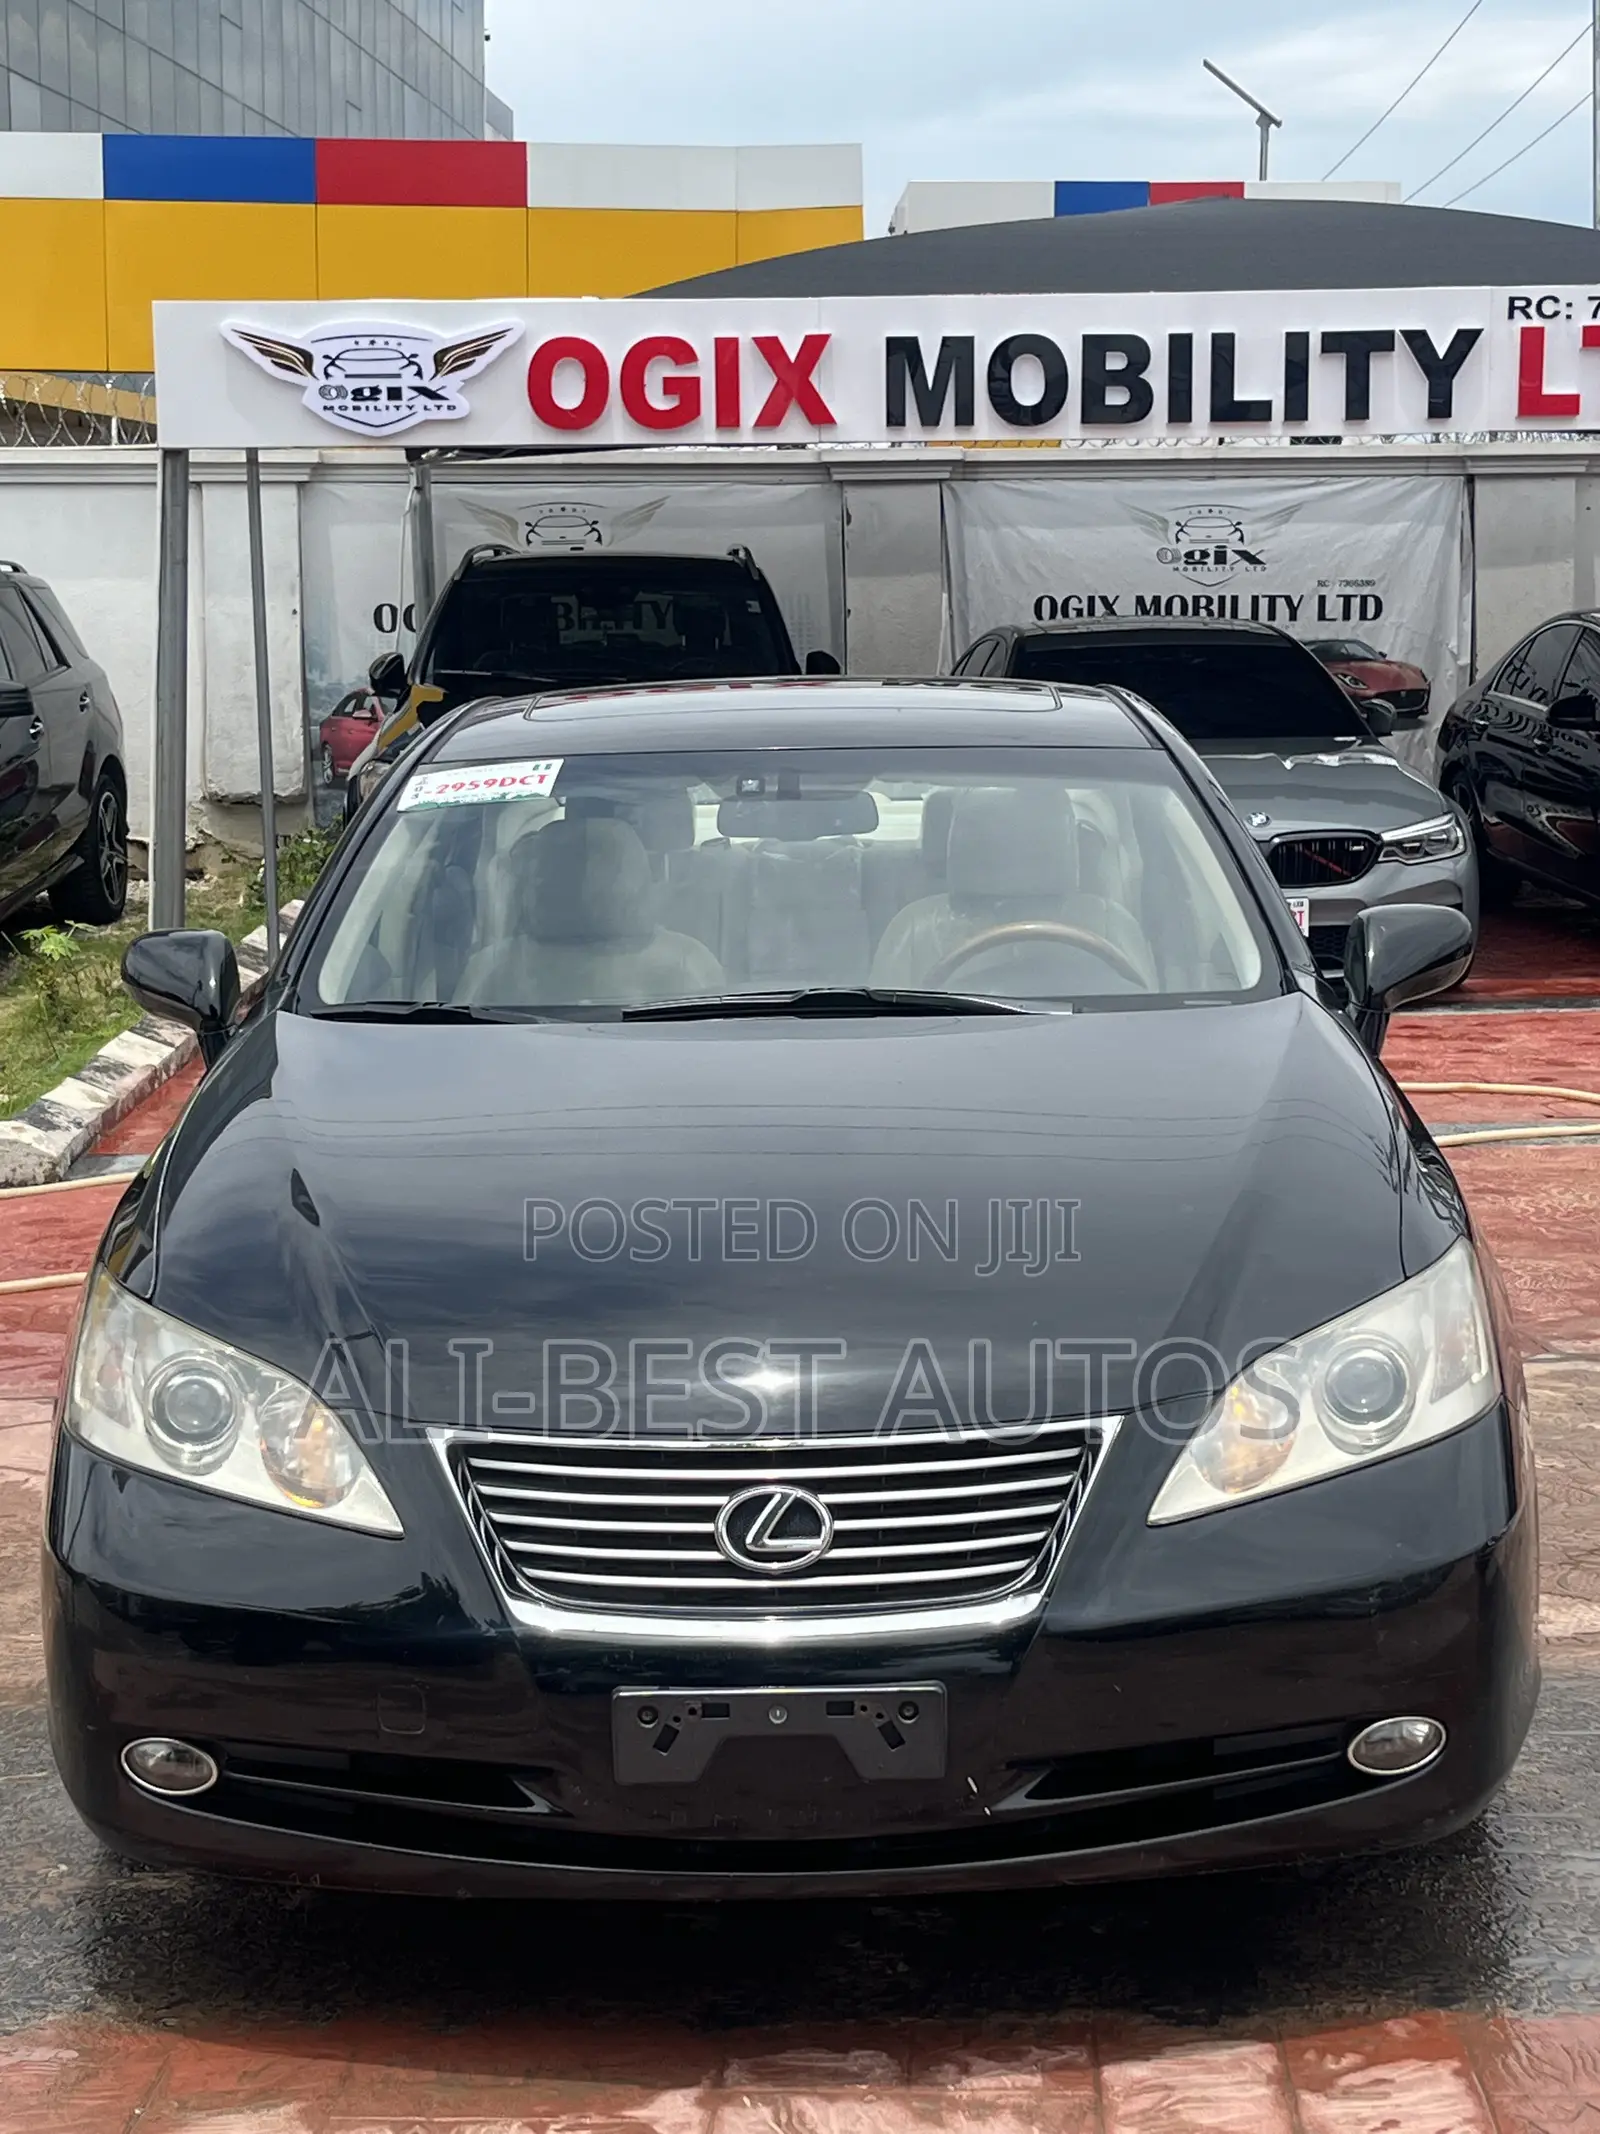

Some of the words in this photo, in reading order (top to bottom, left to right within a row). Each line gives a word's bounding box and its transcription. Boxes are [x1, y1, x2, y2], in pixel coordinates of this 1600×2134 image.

[1507, 295, 1573, 320] RC:
[527, 335, 838, 430] OGIX
[886, 328, 1484, 427] MOBILITY
[1517, 325, 1600, 417] L
[323, 404, 415, 412] MOBILITY
[1033, 594, 1120, 618] OGIX
[1135, 594, 1305, 622] MOBILITY
[1317, 594, 1383, 622] LTD
